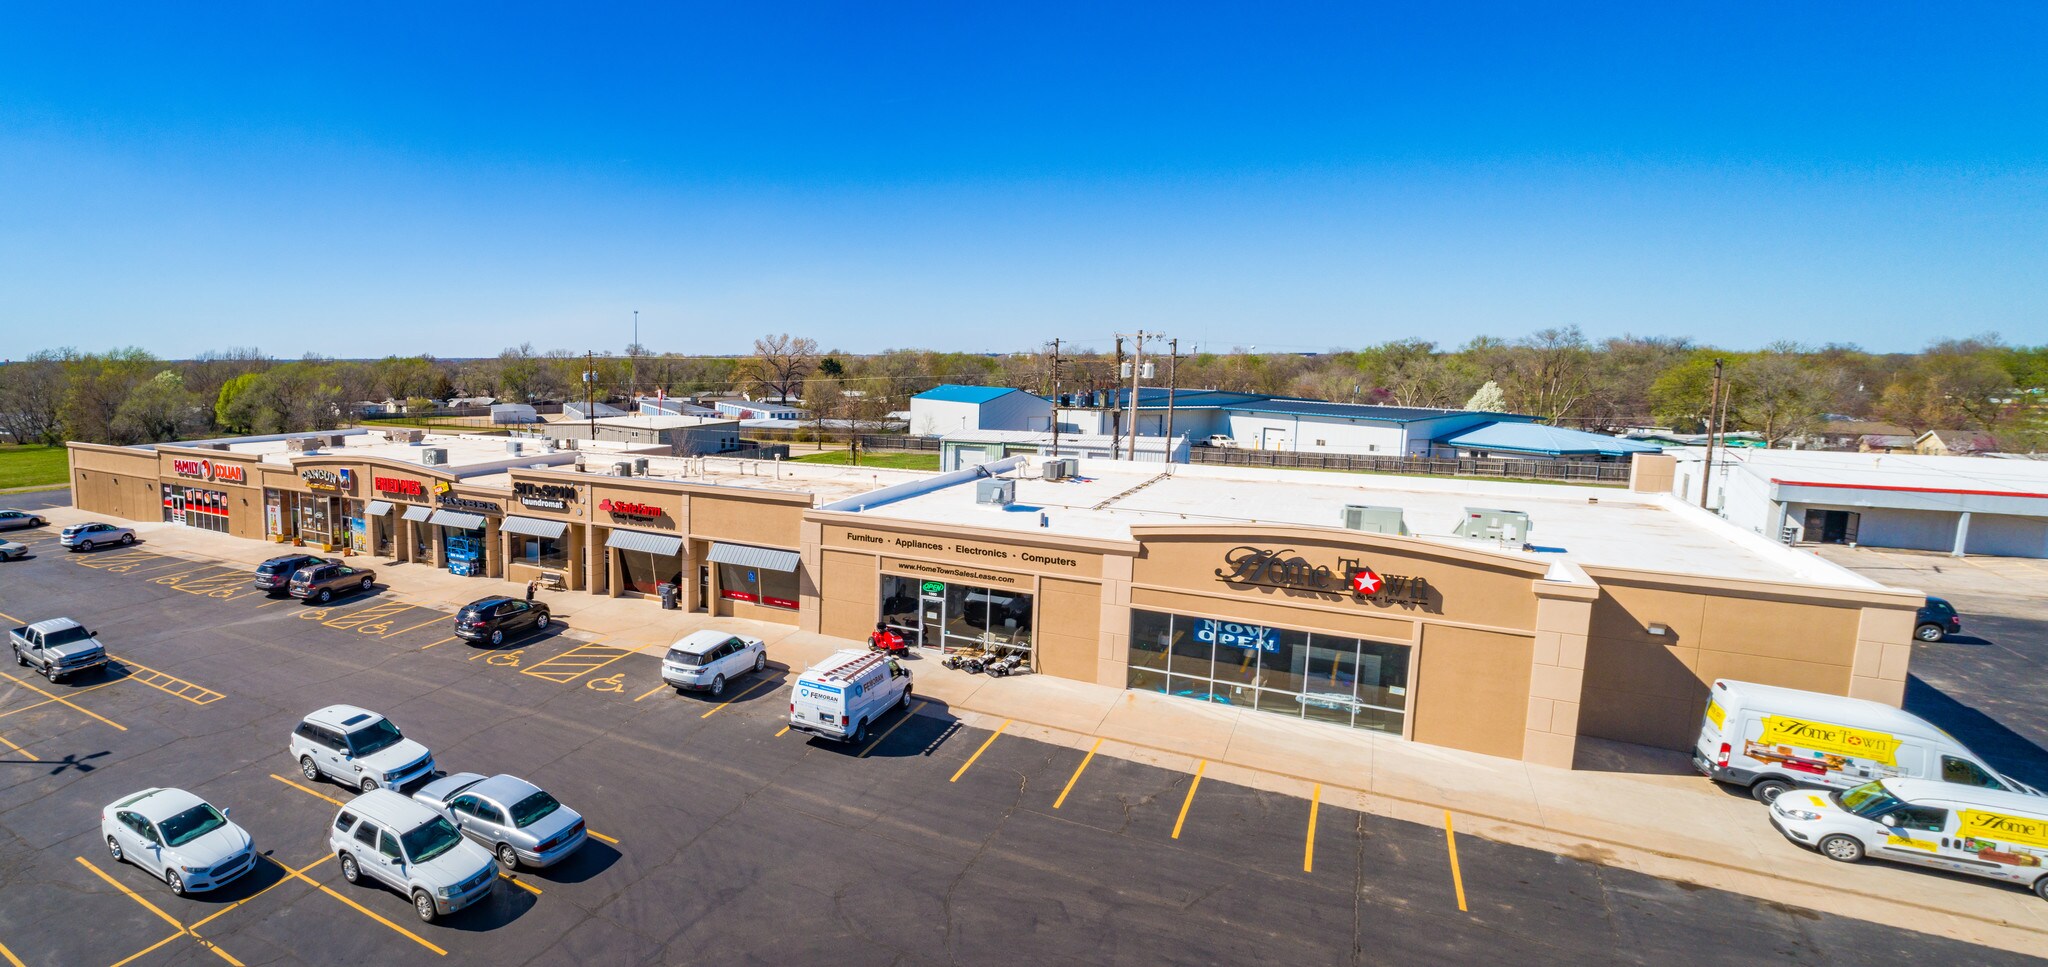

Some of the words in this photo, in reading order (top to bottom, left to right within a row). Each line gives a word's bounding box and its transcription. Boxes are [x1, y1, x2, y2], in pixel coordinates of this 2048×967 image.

[174, 459, 198, 474] FAMILY
[301, 469, 336, 484] CANCUN
[375, 477, 400, 493] FRIED
[400, 479, 422, 495] PIES
[513, 481, 536, 495] SIT
[541, 484, 576, 500] SPIN
[436, 495, 499, 510] BARBER
[522, 496, 564, 509] laundromat
[847, 532, 884, 544] Furniture
[895, 537, 943, 551] Appliances
[955, 544, 1007, 559] Electronics
[1021, 552, 1077, 567] Computers
[898, 562, 1015, 584] www.HomeTownSalesLease.com
[1214, 546, 1331, 590] Home
[924, 583, 942, 591] OPEN
[1203, 619, 1272, 638] NOW
[1197, 629, 1275, 651] OPEN
[863, 673, 884, 693] FEMORAN
[810, 691, 839, 702] FEMORAN
[1773, 719, 1836, 742] Home
[1970, 813, 2036, 835] Home
